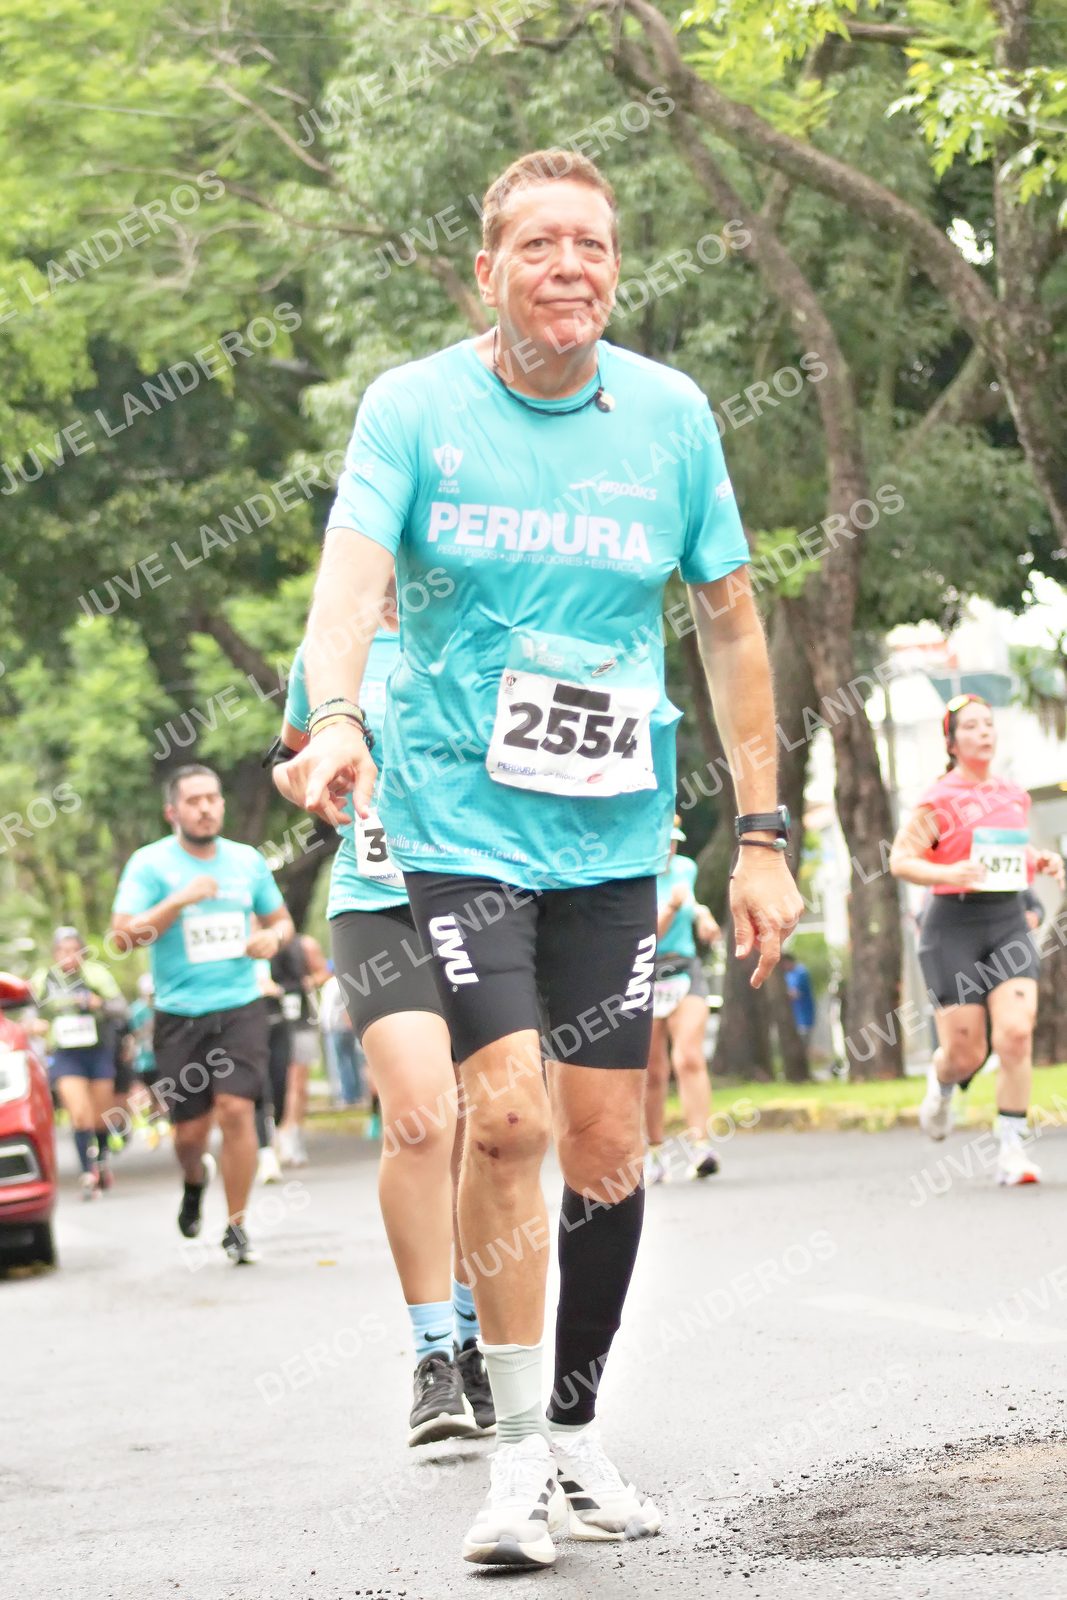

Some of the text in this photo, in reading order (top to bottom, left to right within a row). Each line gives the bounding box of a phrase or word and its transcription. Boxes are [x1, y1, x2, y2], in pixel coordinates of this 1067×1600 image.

[598, 481, 657, 501] BROOKS
[427, 501, 653, 564] PERDURA
[503, 702, 639, 759] 2554
